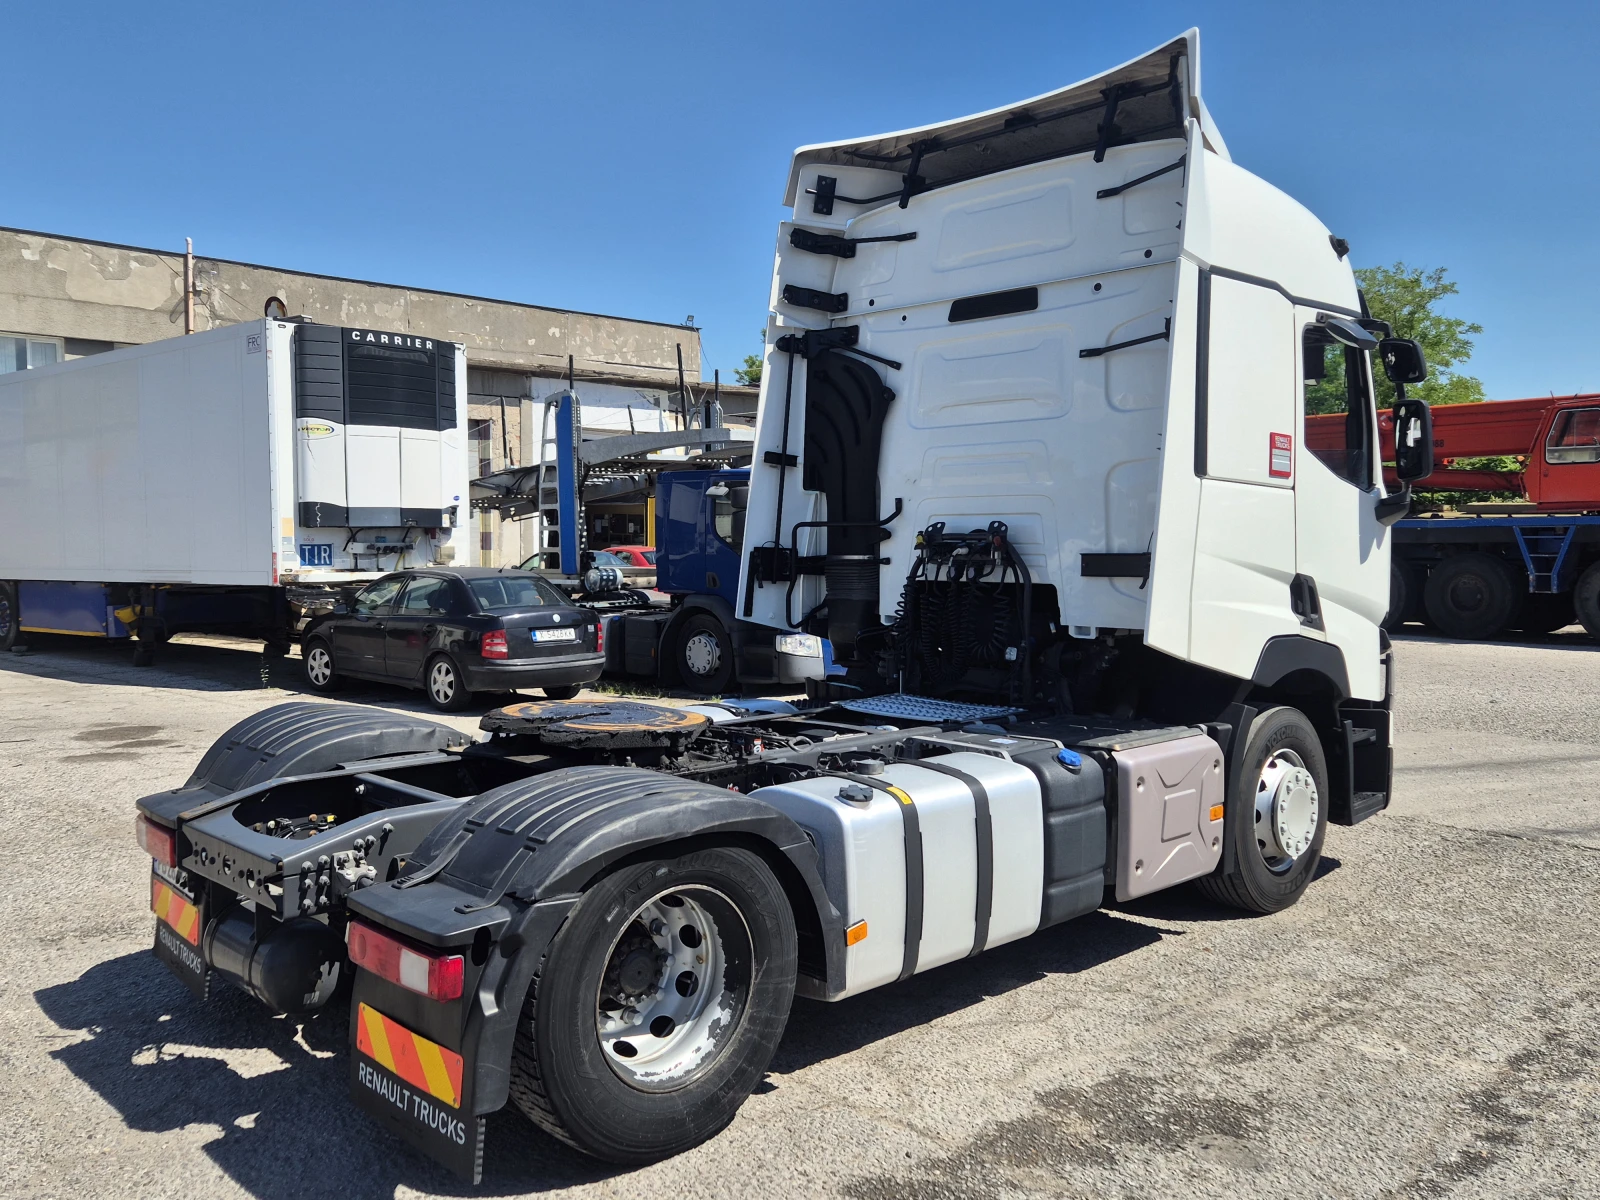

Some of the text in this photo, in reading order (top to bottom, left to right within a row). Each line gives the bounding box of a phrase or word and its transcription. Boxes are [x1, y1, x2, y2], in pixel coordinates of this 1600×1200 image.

[247, 335, 260, 347] FRC
[351, 331, 432, 349] CARRIER
[1275, 435, 1290, 443] RENAULT
[1275, 441, 1290, 449] TRUCKS
[302, 546, 330, 564] TIR
[159, 925, 202, 974] RENAULT TRUCKS
[358, 1061, 466, 1145] RENAULT TRUCKS
